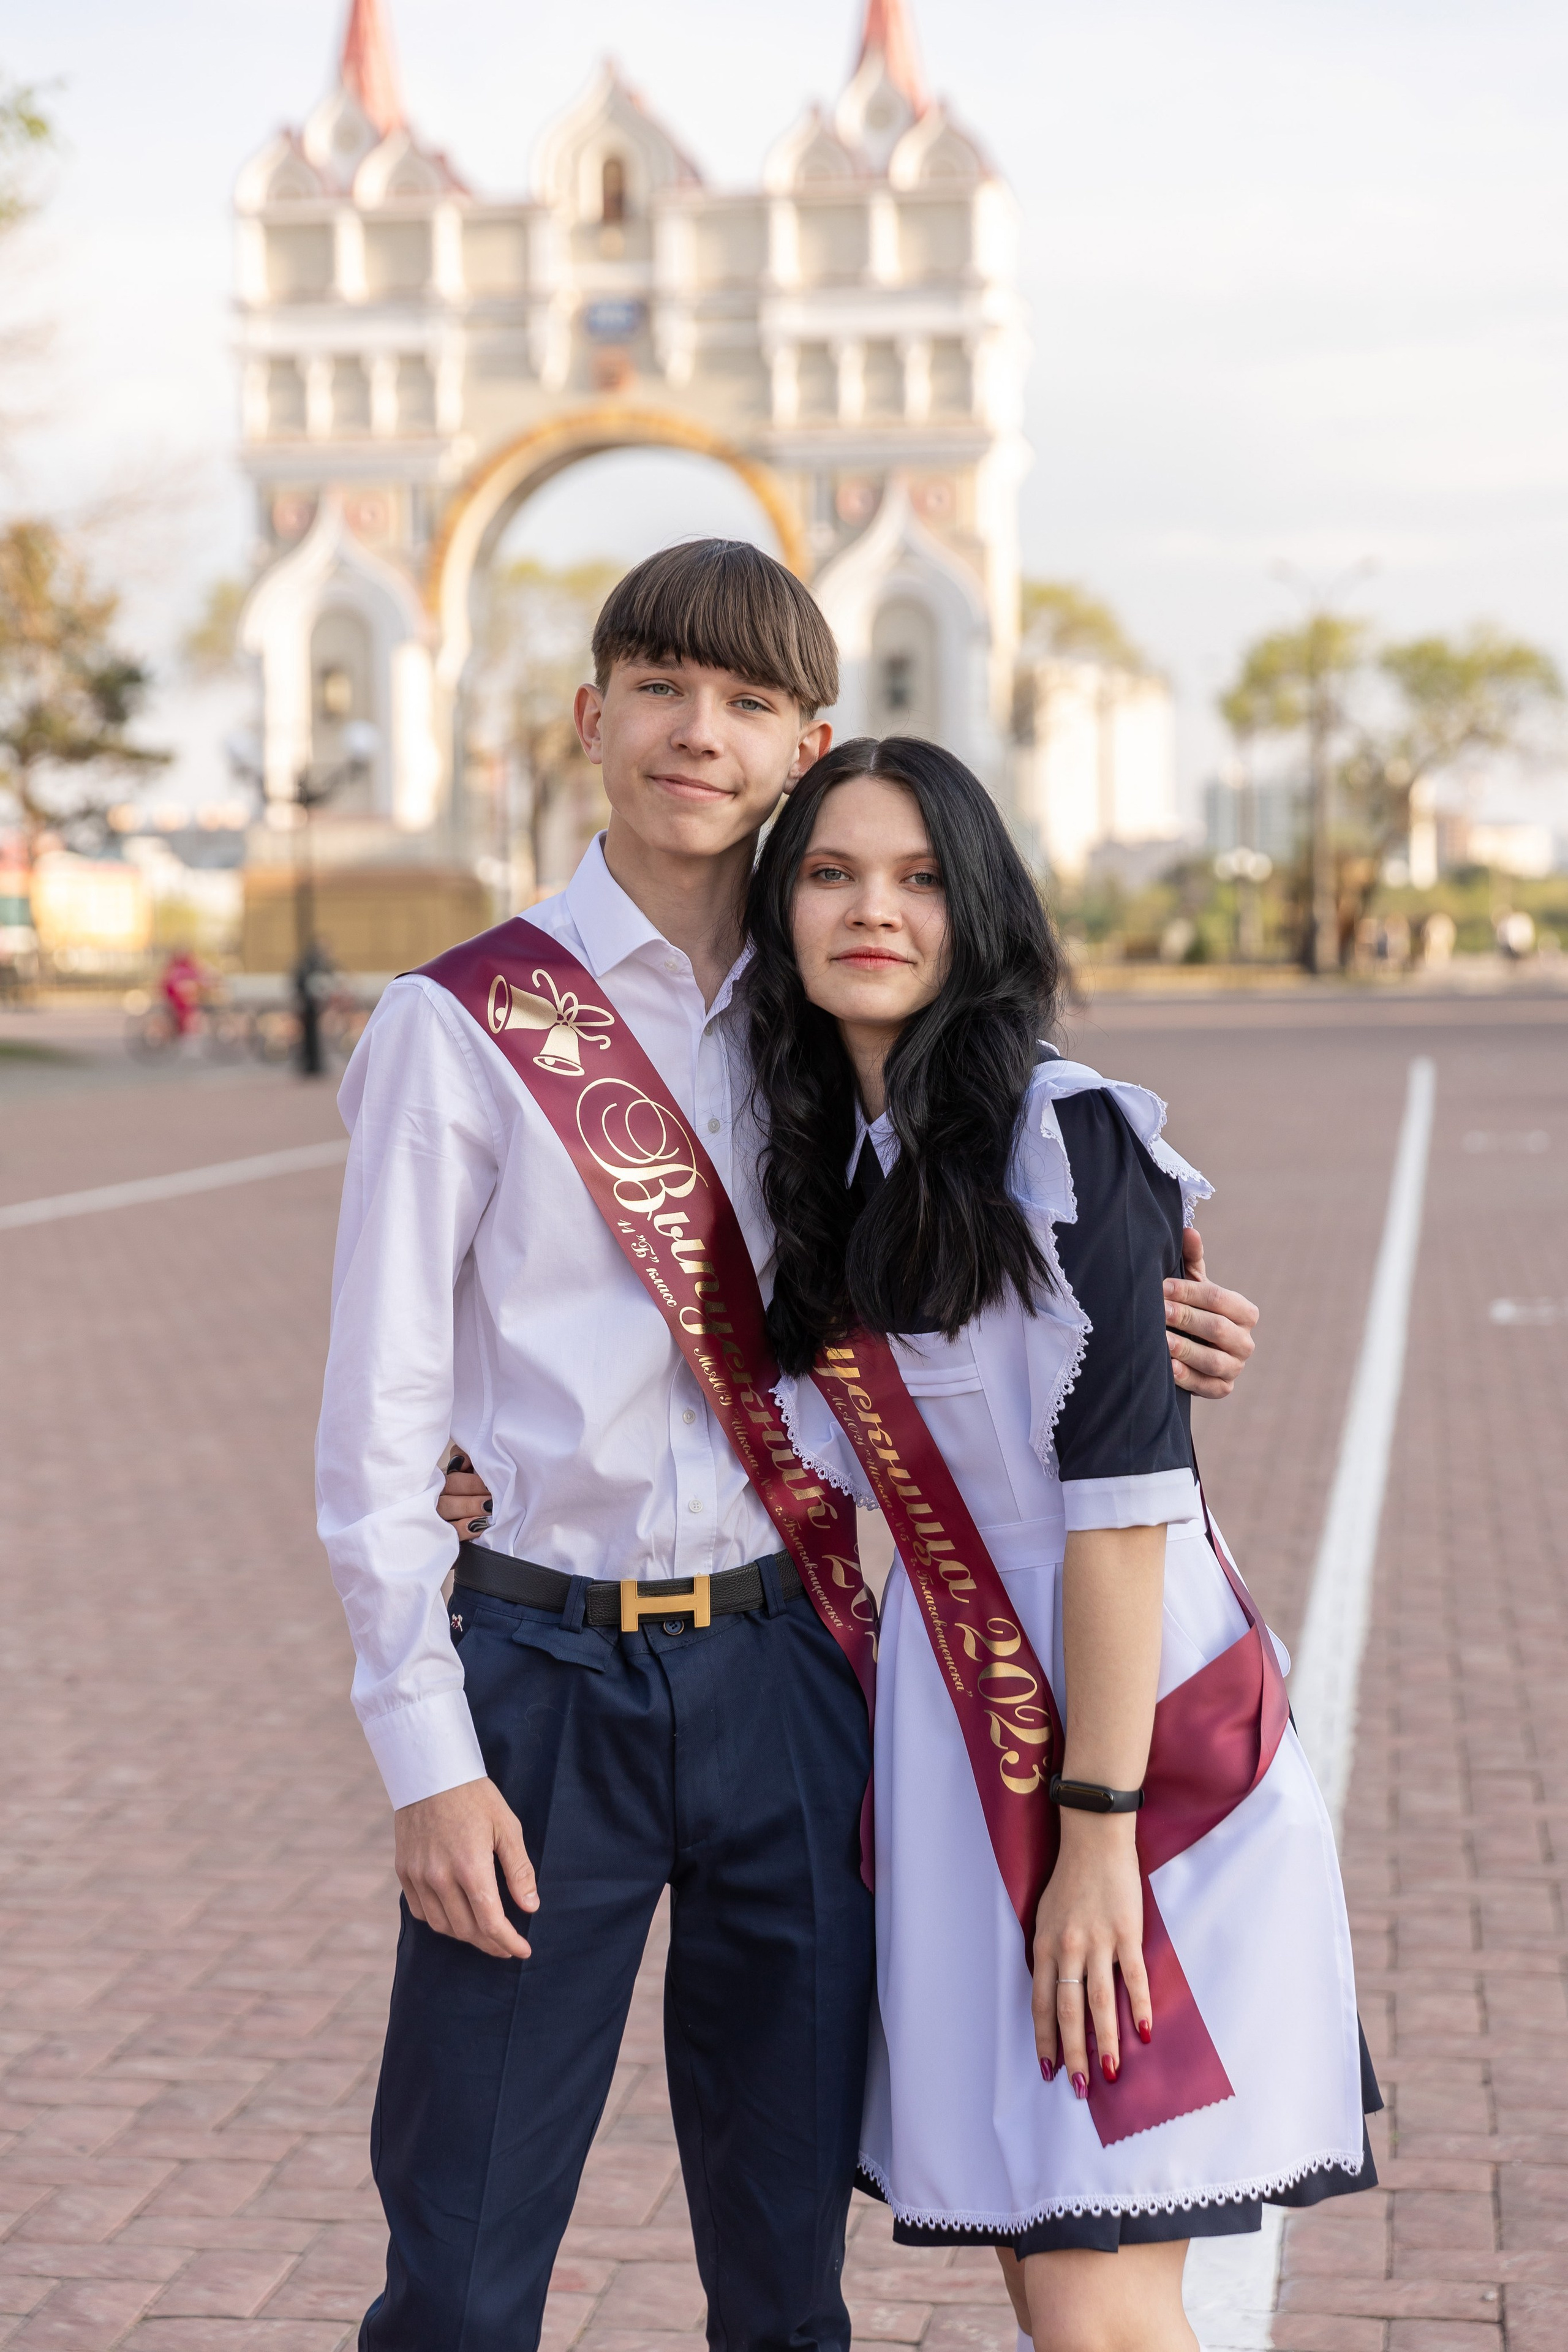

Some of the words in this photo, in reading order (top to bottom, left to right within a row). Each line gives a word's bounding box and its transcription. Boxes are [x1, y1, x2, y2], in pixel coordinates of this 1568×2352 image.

[576, 1077, 838, 1529] Выпускник
[617, 1219, 636, 1234] 11
[645, 1267, 677, 1308] класс
[693, 1348, 733, 1406] МАОУ
[782, 1517, 854, 1632] Благовещенска"
[826, 1388, 865, 1446] МАОУ
[915, 1569, 974, 1698] Благовещенска"
[954, 1617, 1054, 1795] 2023
